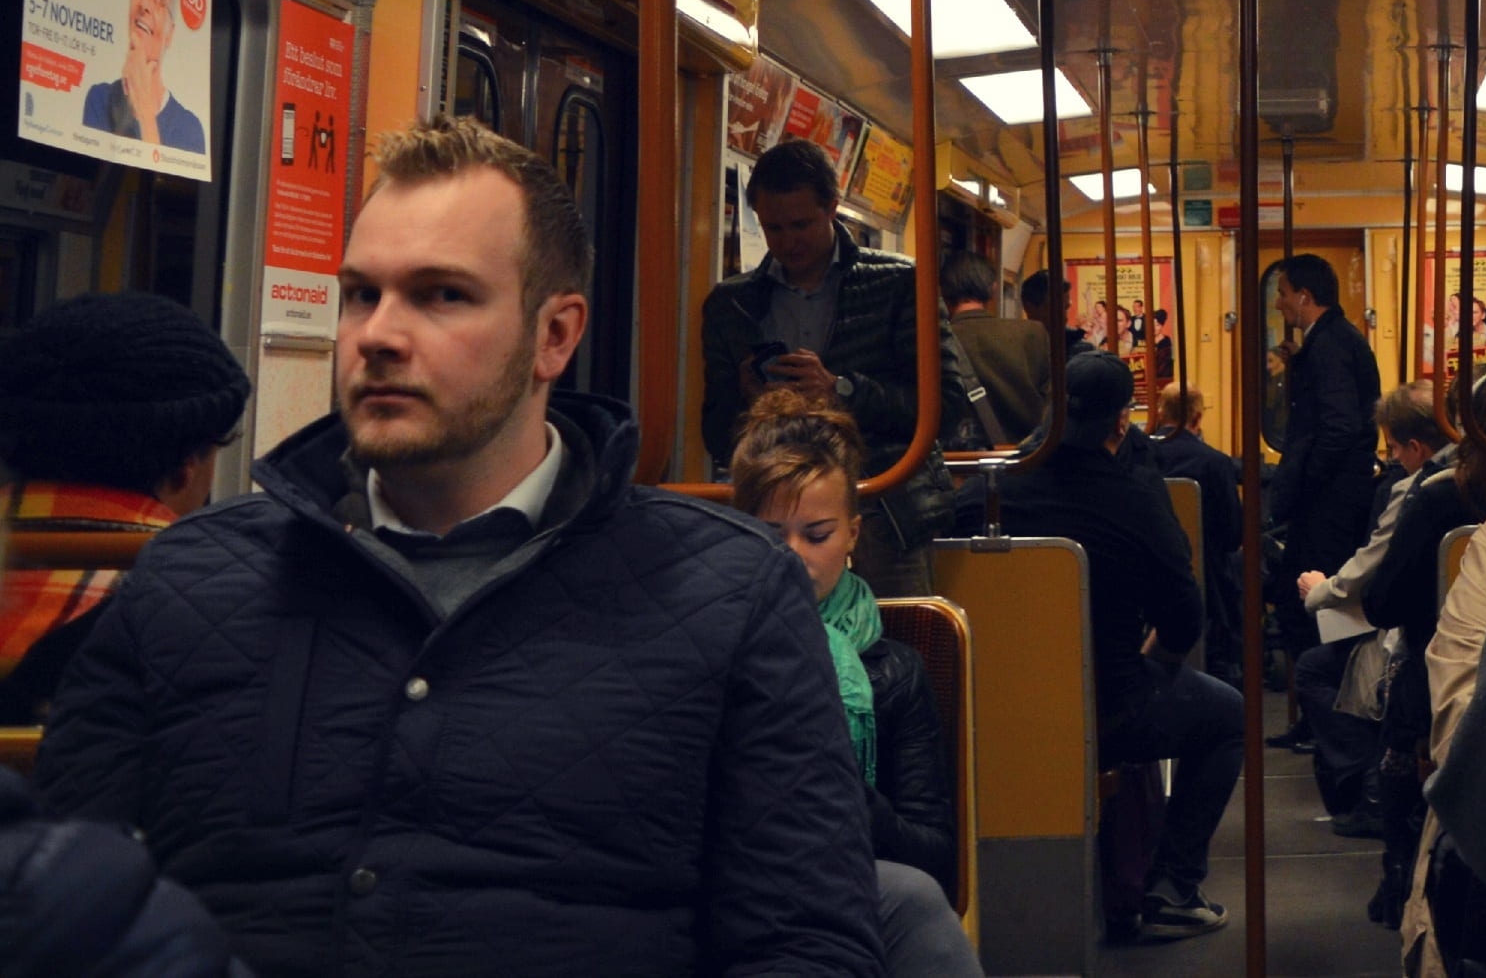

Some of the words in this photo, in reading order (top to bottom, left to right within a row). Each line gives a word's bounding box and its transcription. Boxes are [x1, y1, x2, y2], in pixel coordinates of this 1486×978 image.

[50, 2, 115, 44] NOVEMBER
[299, 45, 325, 72] beslut
[324, 59, 343, 78] som
[283, 66, 325, 97] förändrar
[271, 283, 329, 304] actionaid
